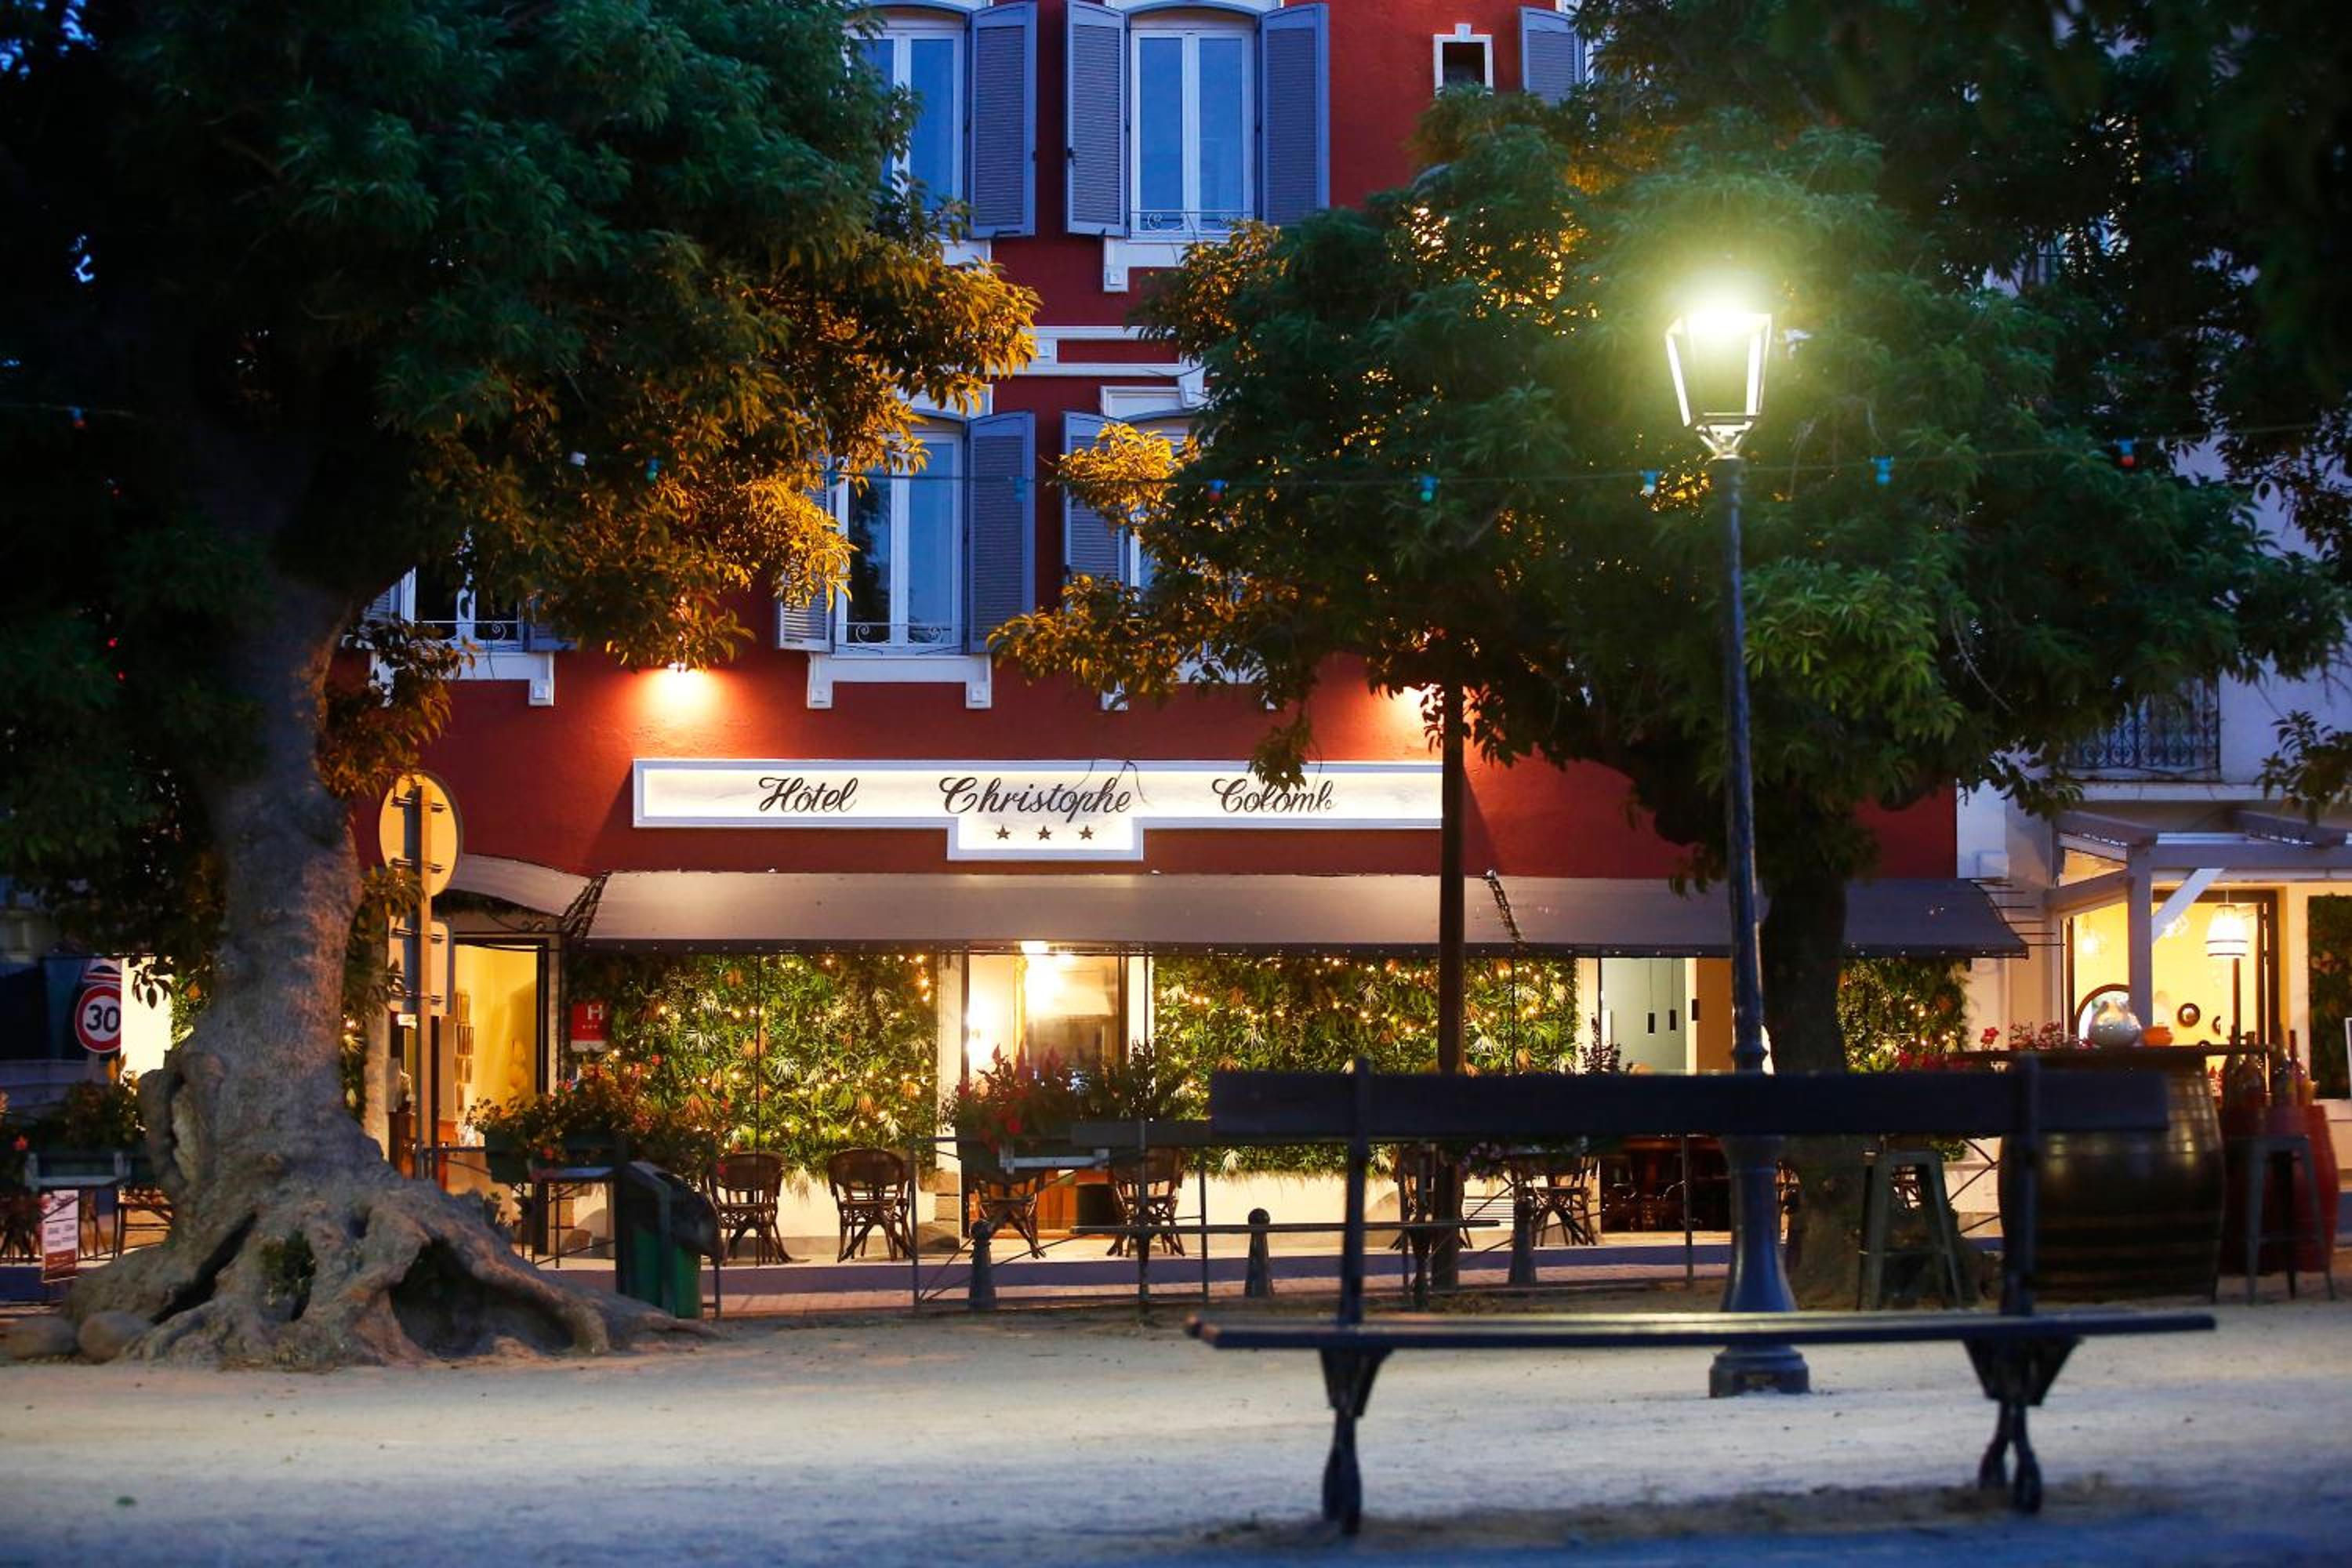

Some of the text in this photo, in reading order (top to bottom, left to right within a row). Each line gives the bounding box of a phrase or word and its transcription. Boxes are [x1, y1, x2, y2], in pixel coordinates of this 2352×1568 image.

[758, 777, 1338, 823] Hôtel Christophe Colomb
[86, 1004, 120, 1033] 30
[587, 1004, 603, 1020] H
